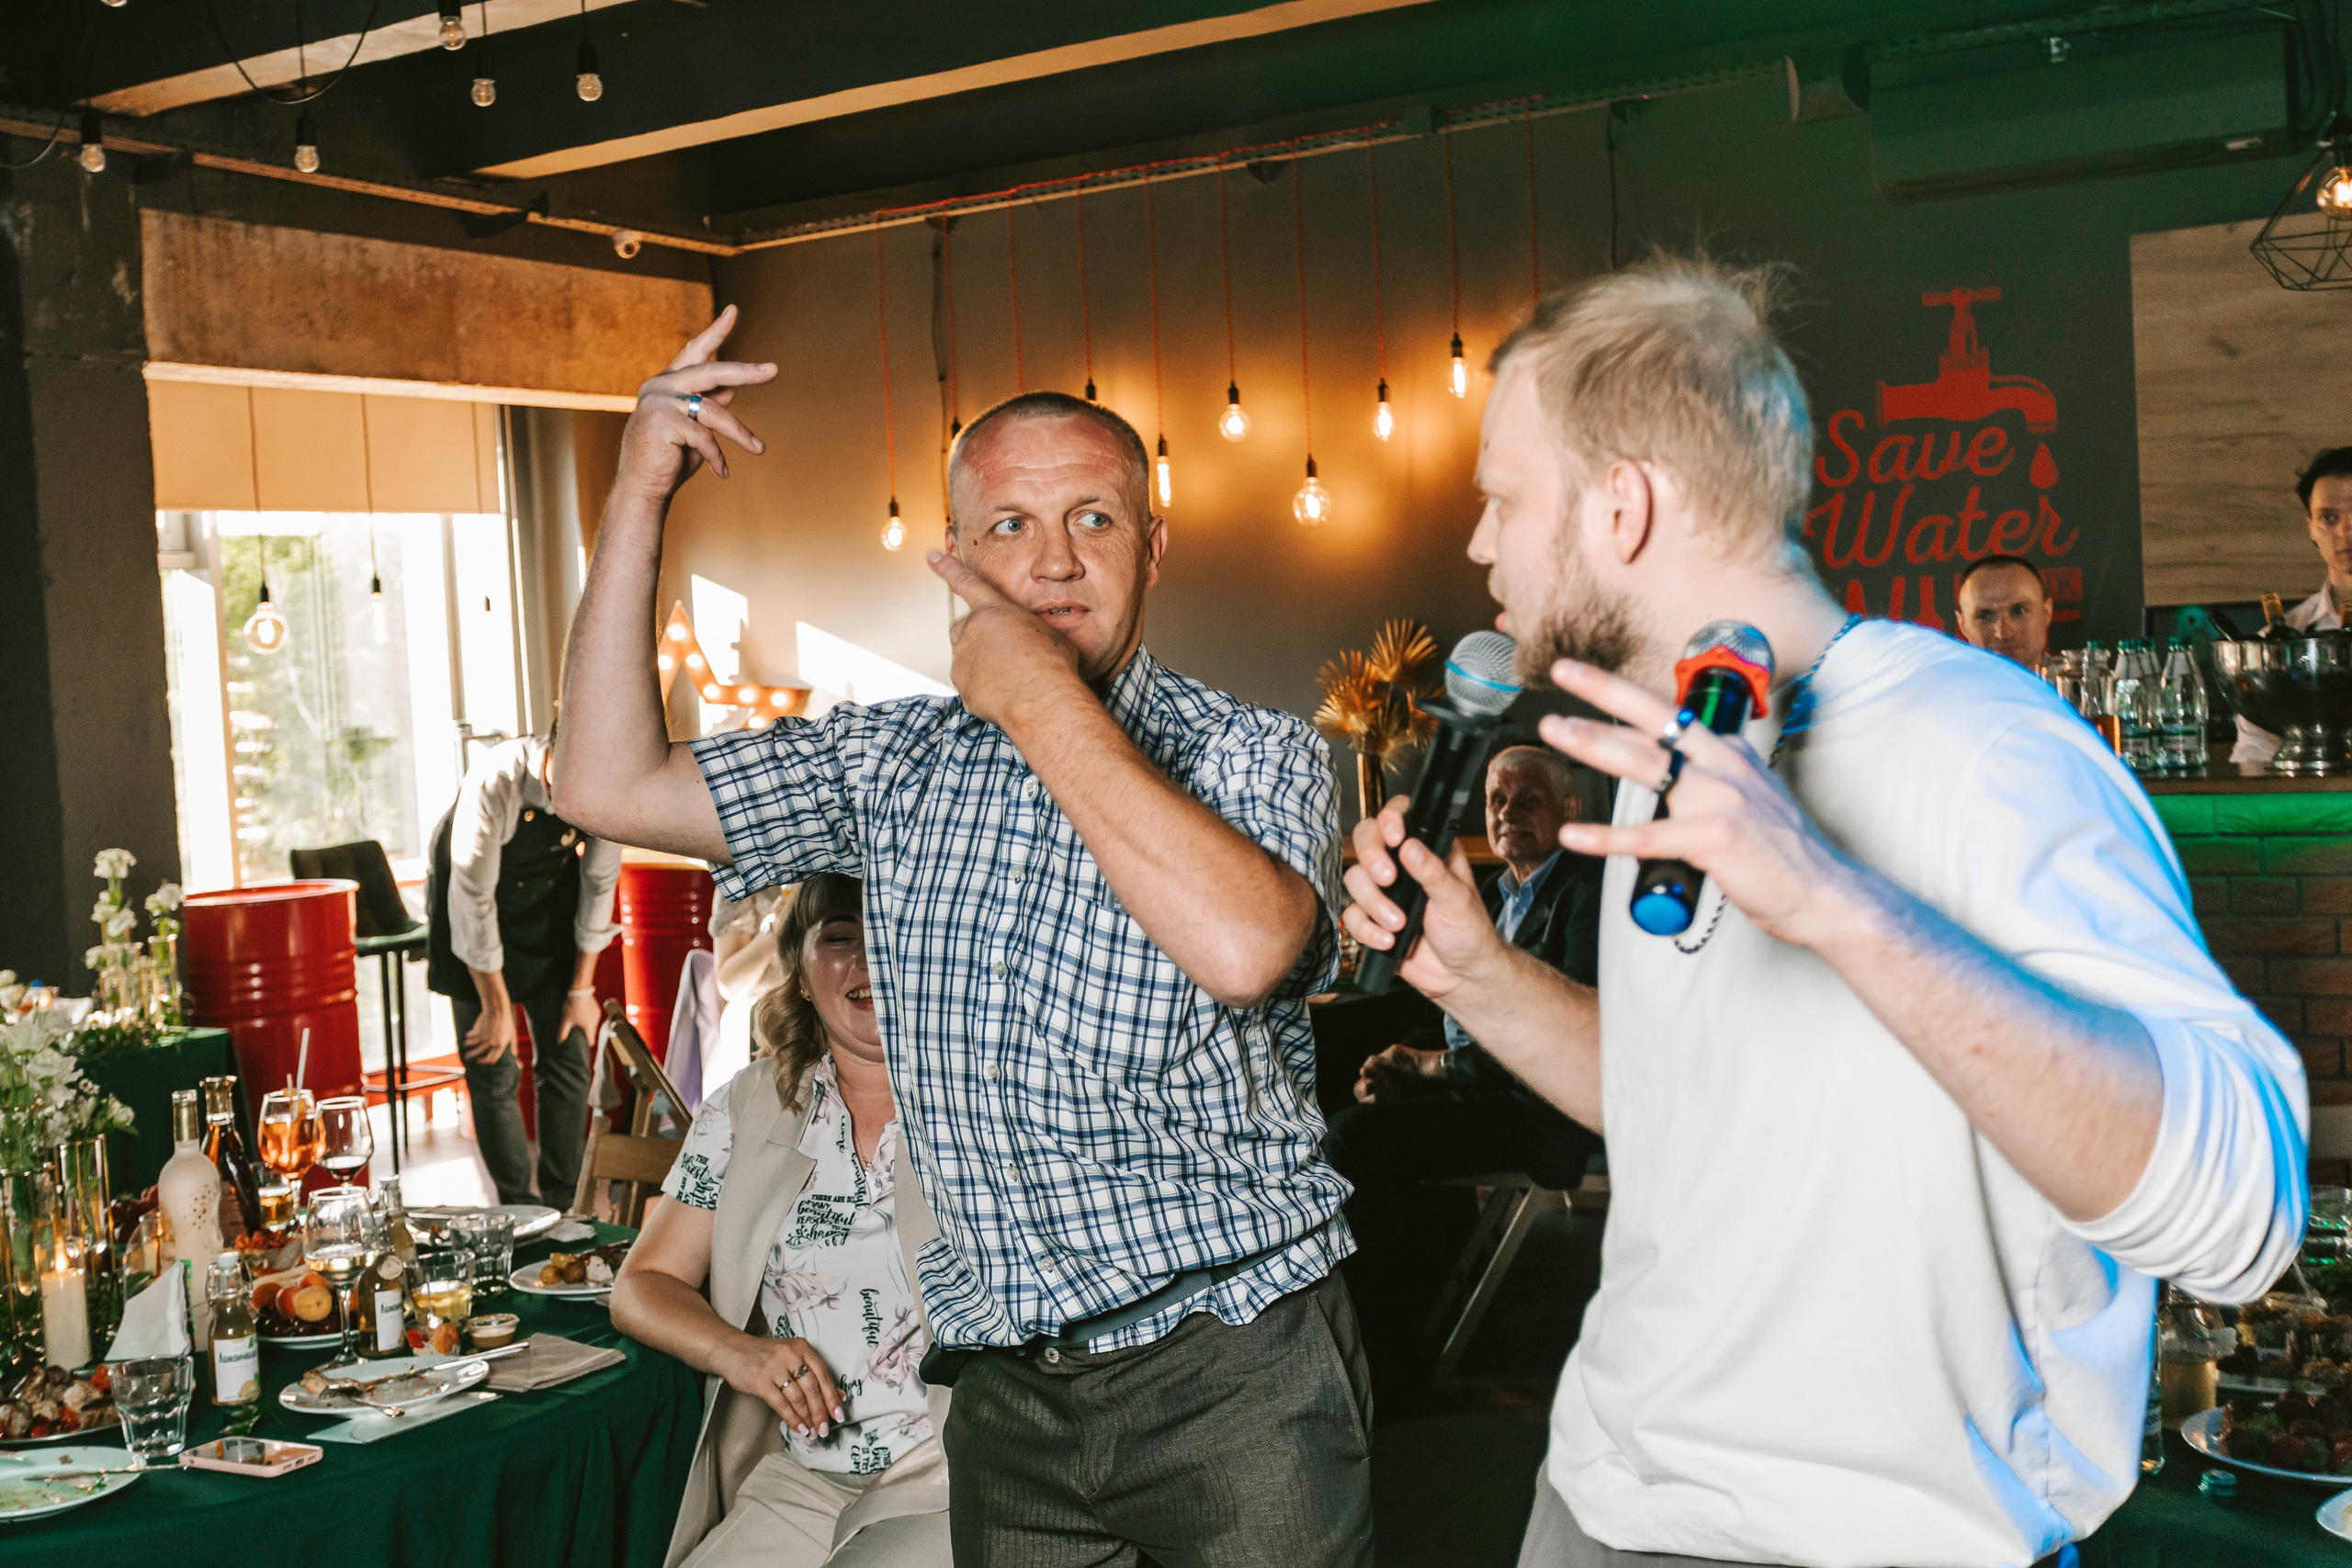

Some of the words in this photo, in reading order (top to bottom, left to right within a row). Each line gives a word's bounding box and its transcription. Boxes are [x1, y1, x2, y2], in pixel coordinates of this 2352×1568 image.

[1816, 410, 2016, 488] Save
[1804, 484, 2080, 570] Water
[695, 1154, 709, 1166] THE
[807, 1199, 831, 1210] MANY
[811, 1194, 832, 1202] THERE
[797, 1200, 857, 1225] beautiful
[860, 1288, 883, 1348] beautiful
[849, 1444, 861, 1474] com
